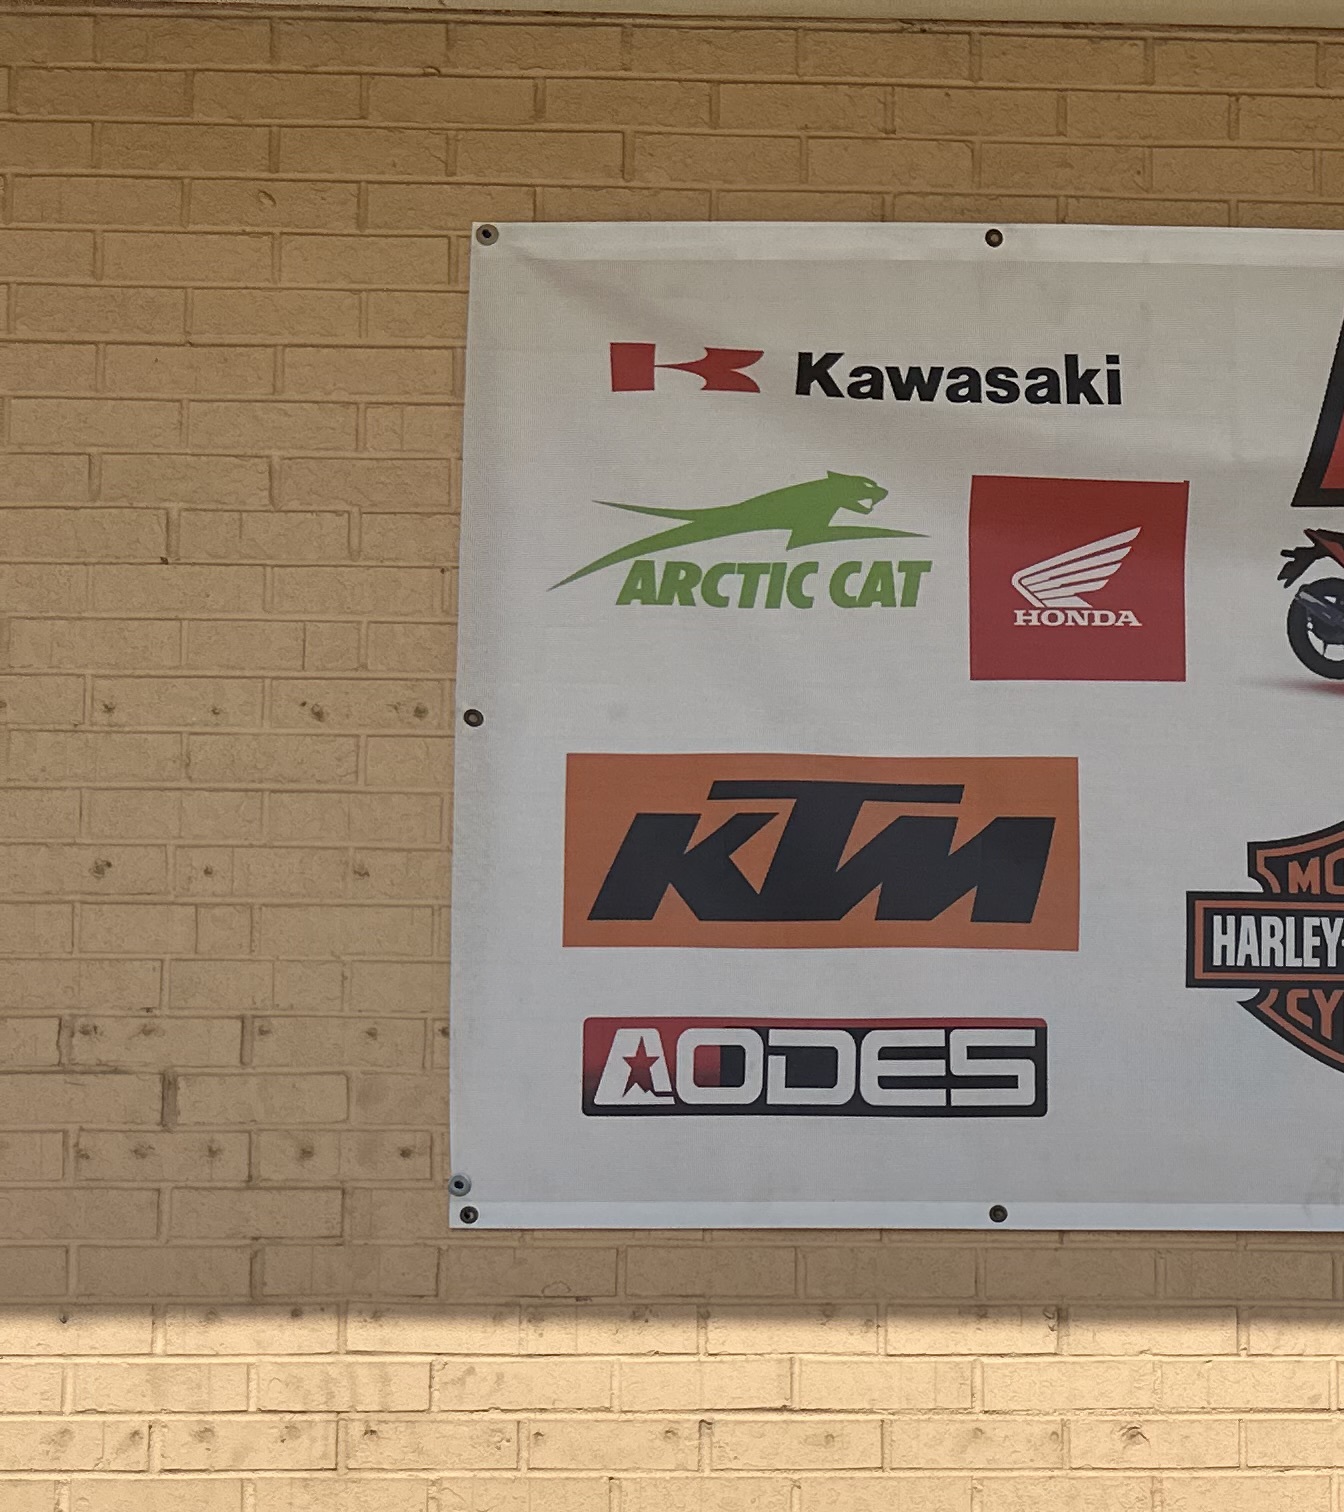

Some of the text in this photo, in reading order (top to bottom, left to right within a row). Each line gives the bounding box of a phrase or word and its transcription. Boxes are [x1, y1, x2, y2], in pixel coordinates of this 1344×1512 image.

[795, 350, 1123, 406] Kawasaki
[614, 559, 933, 609] ARCTIC CAT
[1013, 609, 1143, 628] HONDA
[586, 779, 1058, 924] KTM
[593, 1026, 1037, 1107] AODES
